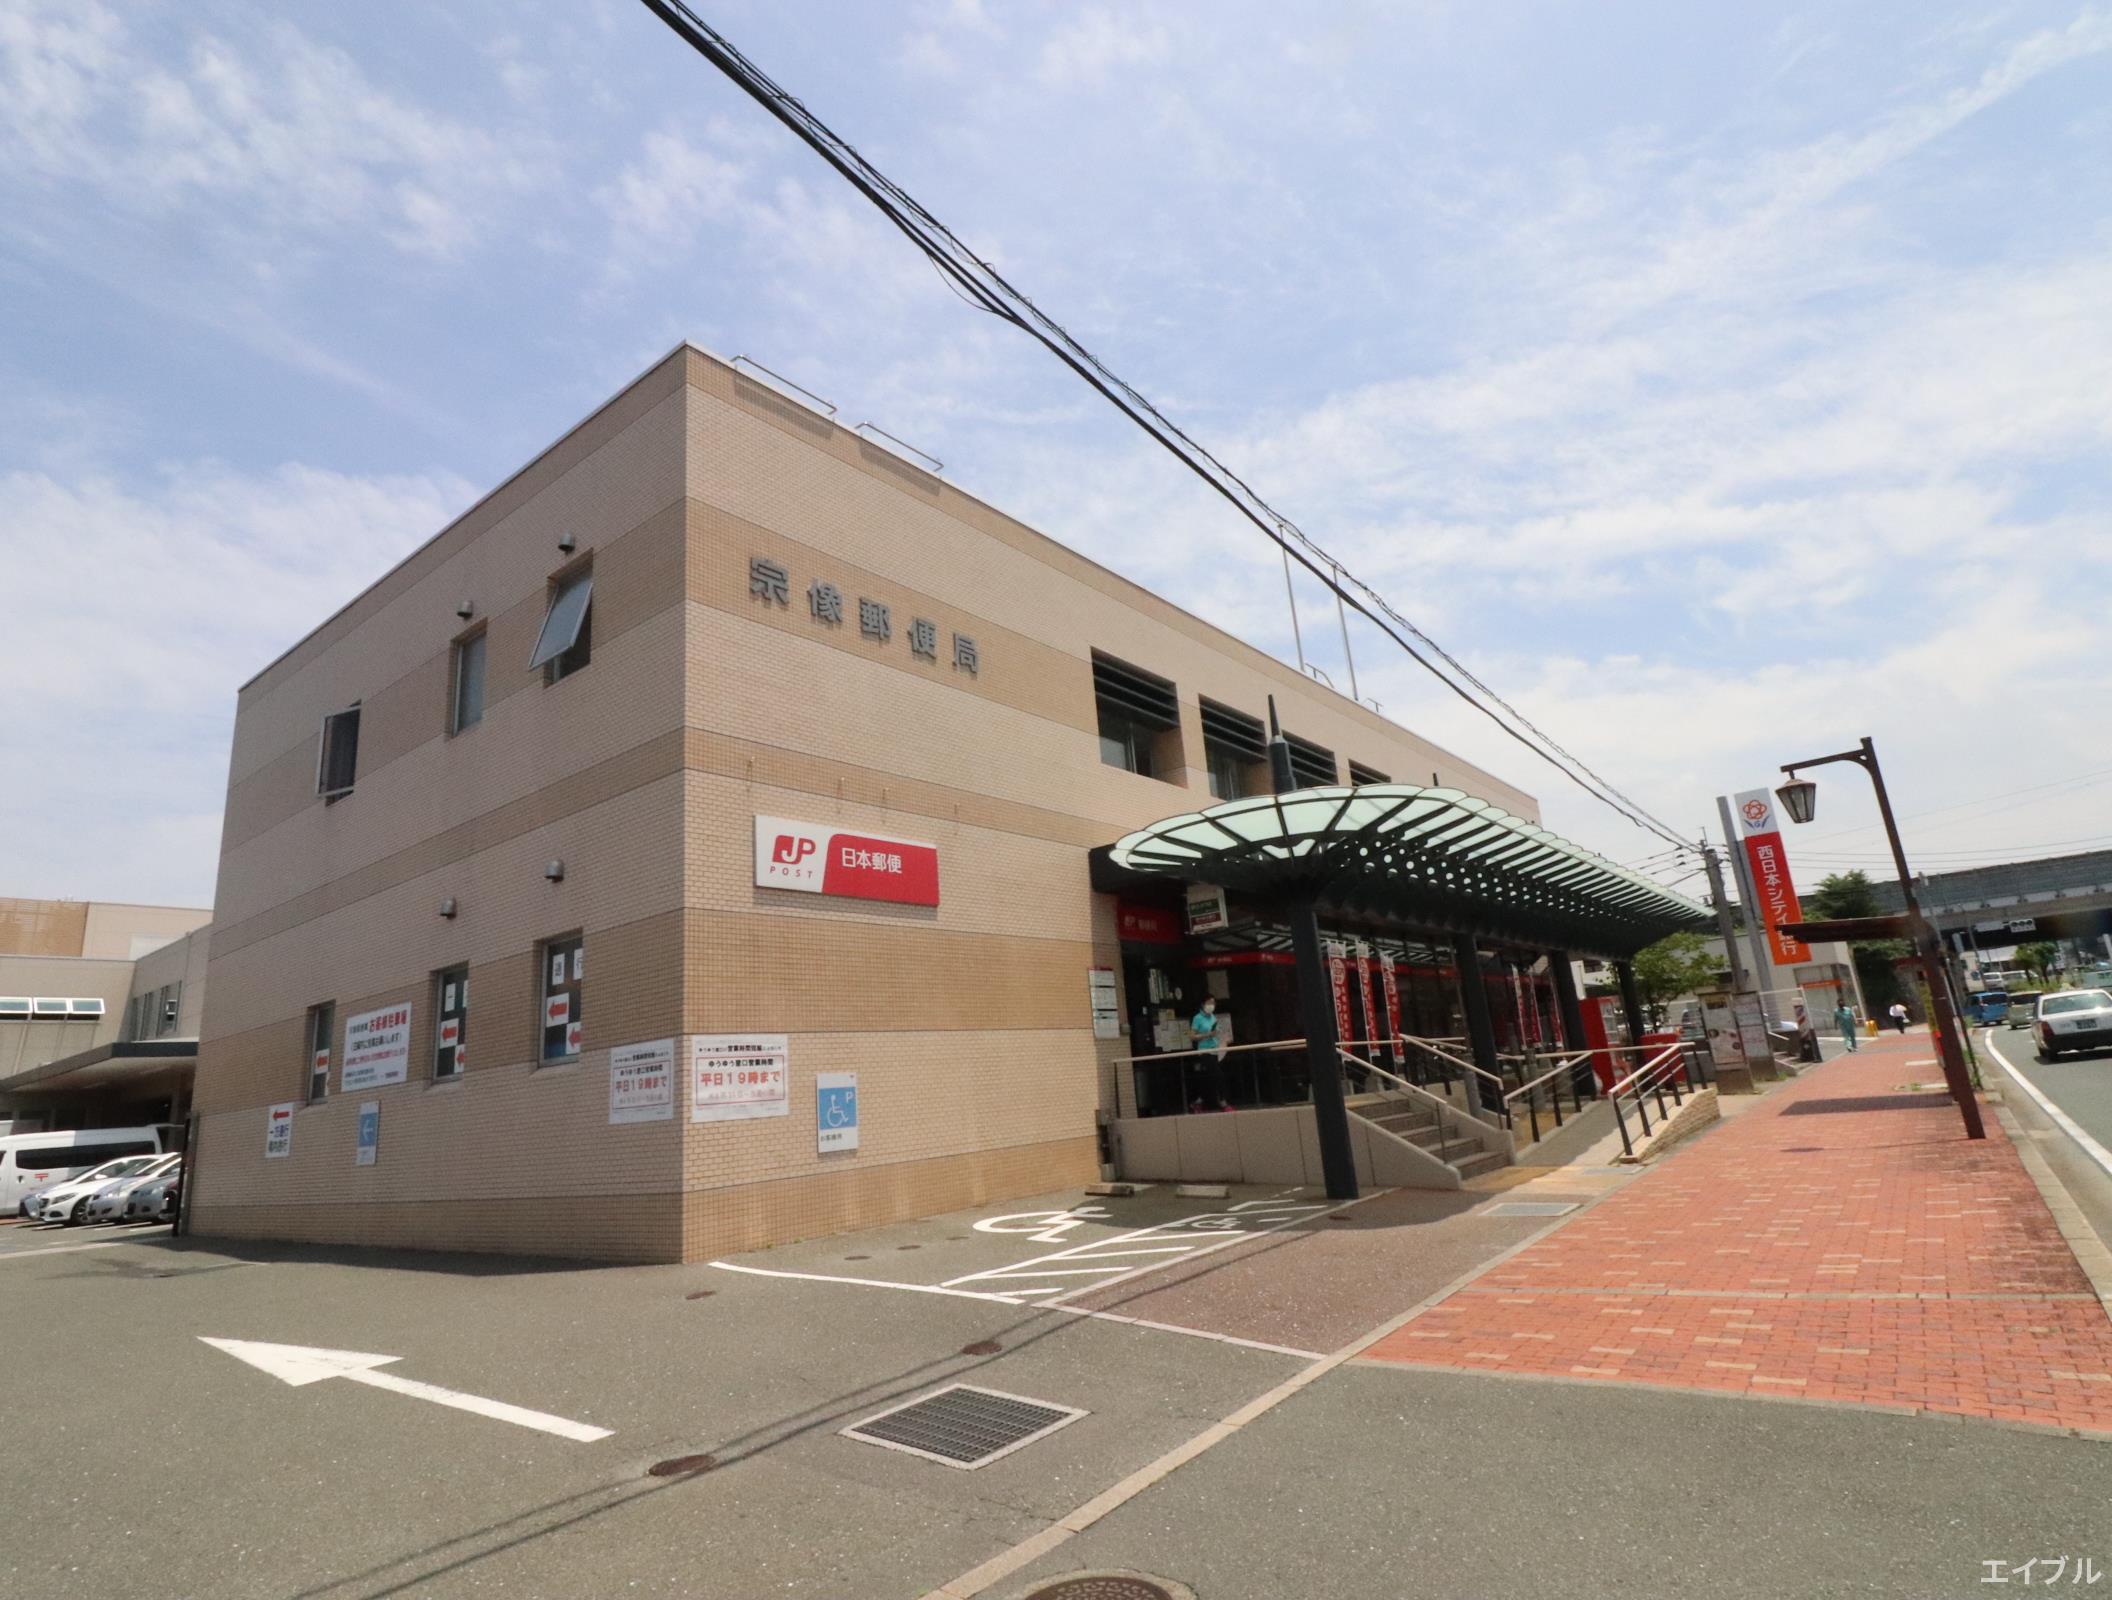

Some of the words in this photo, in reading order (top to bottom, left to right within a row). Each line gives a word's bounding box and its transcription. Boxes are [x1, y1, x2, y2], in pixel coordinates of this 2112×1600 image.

[750, 556, 979, 674] 宗像郵便局
[772, 834, 816, 865] JP
[841, 847, 903, 874] 日本郵便
[769, 865, 813, 879] POST
